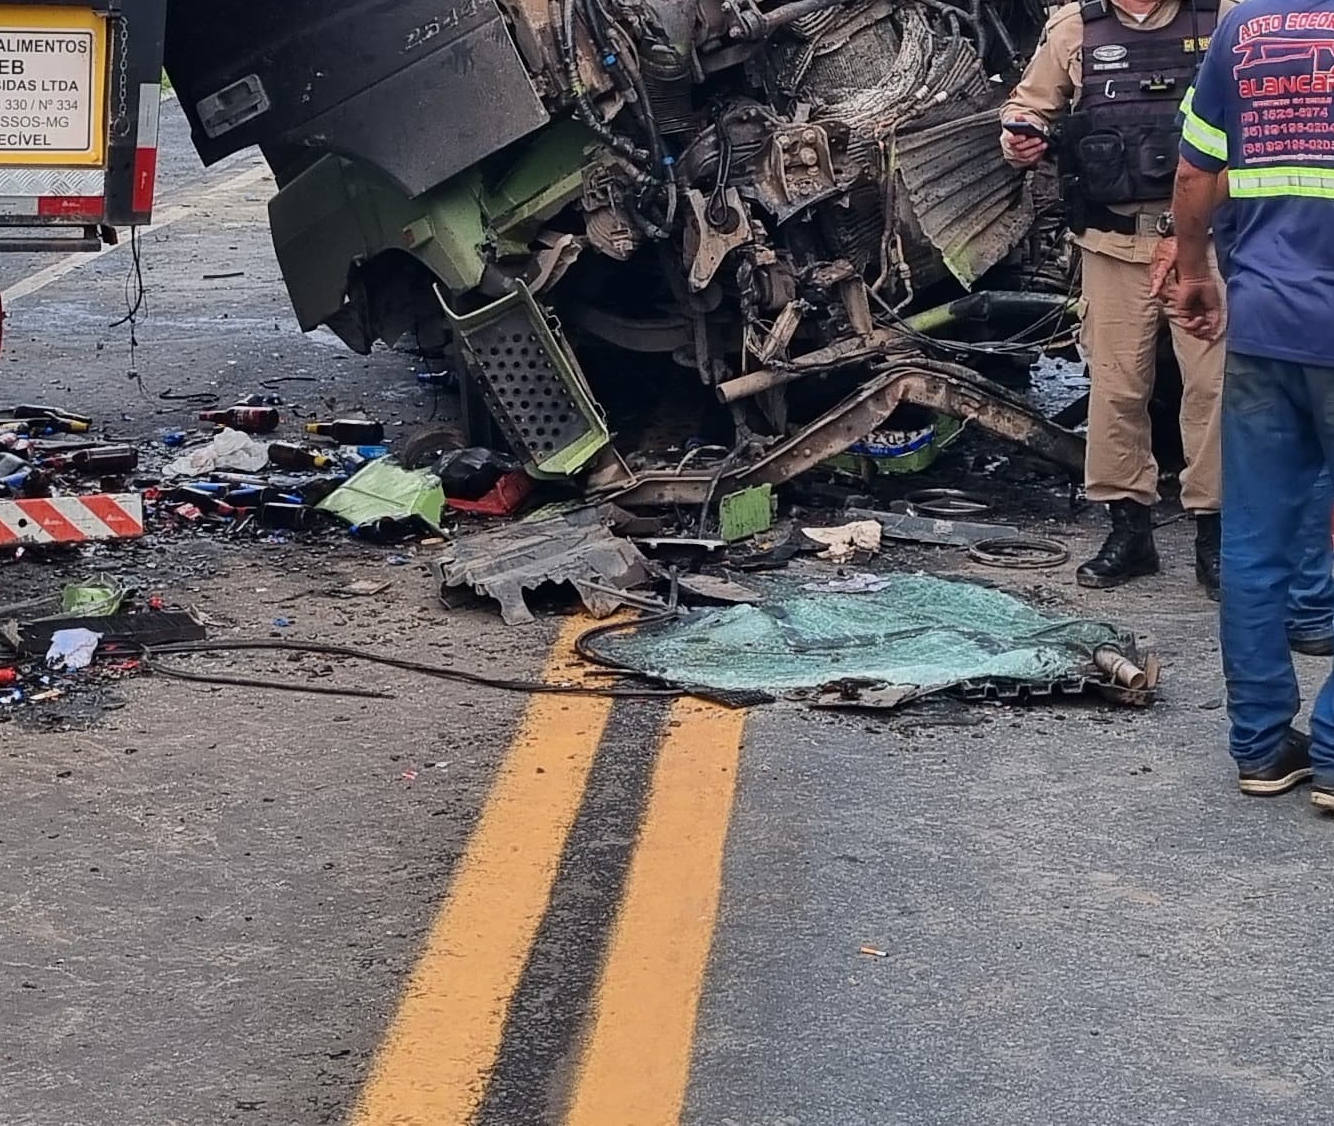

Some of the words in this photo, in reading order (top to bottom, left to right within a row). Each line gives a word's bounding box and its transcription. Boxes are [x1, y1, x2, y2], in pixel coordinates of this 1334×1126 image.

[1238, 13, 1283, 42] AUTO
[42, 80, 79, 92] LTDA
[5, 99, 27, 110] 330
[56, 100, 78, 111] 334
